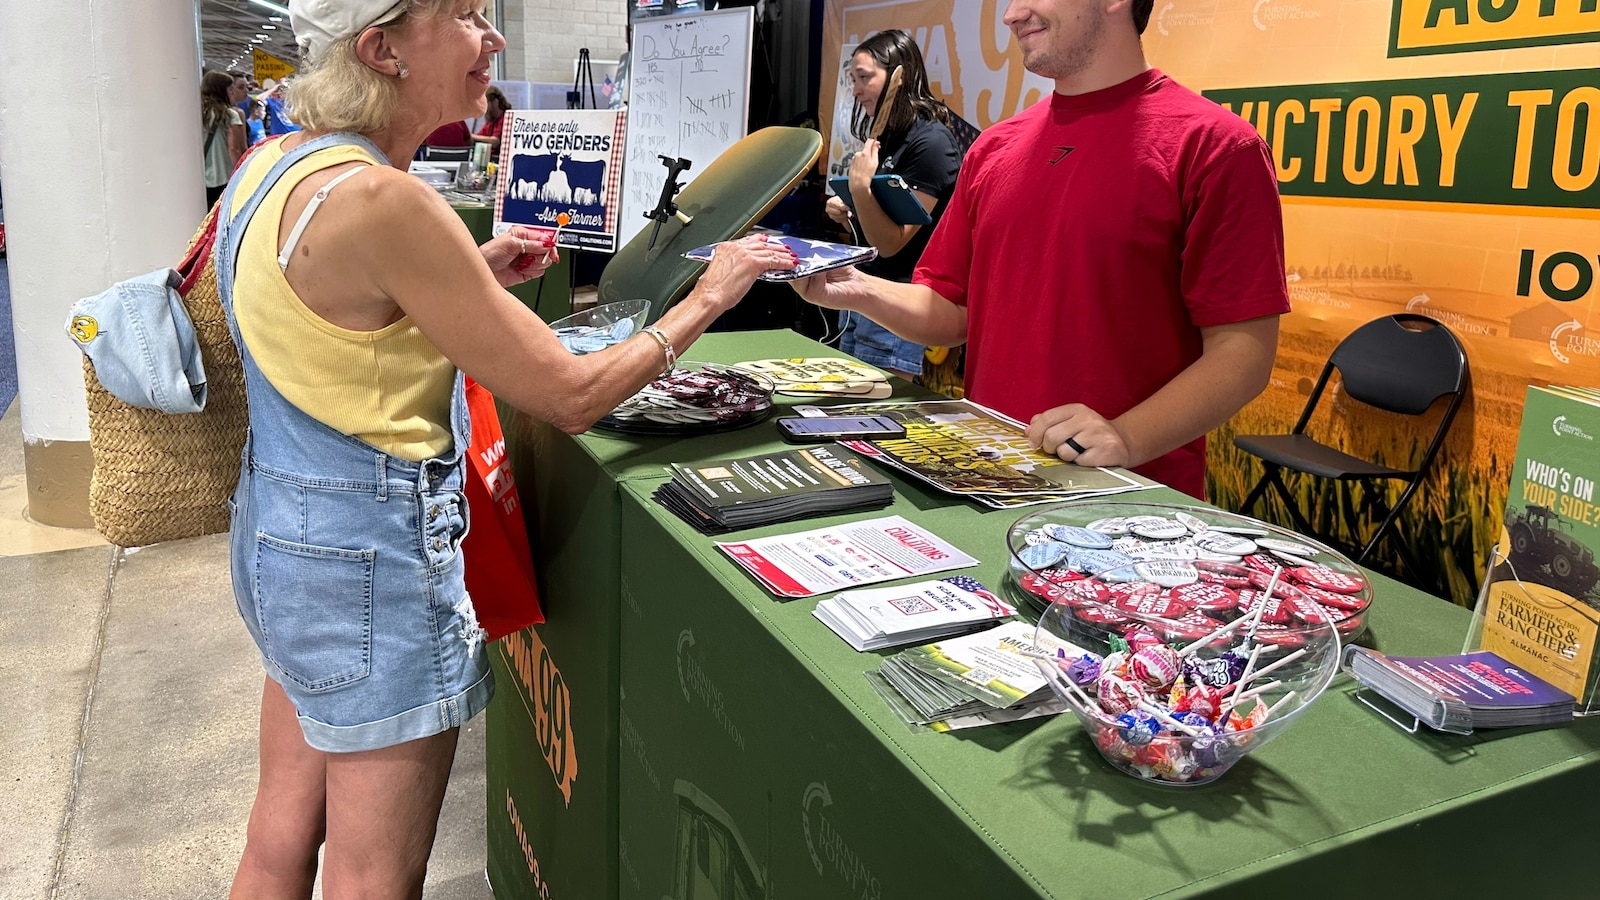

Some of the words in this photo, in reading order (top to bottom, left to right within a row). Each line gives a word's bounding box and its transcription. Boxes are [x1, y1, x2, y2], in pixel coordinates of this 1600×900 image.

[642, 35, 660, 59] Do
[669, 35, 685, 58] You
[690, 34, 731, 61] Agree?
[256, 63, 285, 71] PASSING
[514, 117, 540, 133] There
[540, 122, 556, 133] are
[557, 119, 579, 134] only
[513, 134, 543, 150] TWO
[546, 134, 611, 152] GENDERS
[567, 208, 604, 227] Farmer
[1517, 248, 1600, 302] IO
[1420, 307, 1465, 322] TURNING
[1526, 458, 1571, 494] WHO'S
[1573, 476, 1594, 502] ON
[1522, 479, 1558, 512] YOUR
[1558, 494, 1600, 528] SIDE?
[881, 526, 951, 560] COALITIONS
[923, 590, 957, 612] REGISTER
[936, 585, 958, 600] SCAN
[954, 597, 977, 611] HERE
[943, 596, 955, 604] TO
[1136, 593, 1158, 613] CHASE
[1152, 597, 1172, 613] VOTE
[1178, 585, 1224, 602] CHASE
[1193, 590, 1230, 604] VOTE
[1501, 591, 1532, 611] TURNING
[1264, 598, 1282, 616] VOTE
[1532, 605, 1554, 622] POINT
[1554, 615, 1581, 633] ACTION
[1499, 597, 1564, 638] FARMERS
[1564, 629, 1578, 645] &
[1510, 638, 1549, 663] ALMANAC
[502, 630, 534, 702] OWA
[687, 651, 724, 710] TURNING
[539, 647, 566, 787] 99
[687, 668, 711, 709] POINT
[712, 702, 745, 753] ACTION
[818, 811, 881, 899] TURNING
[819, 831, 860, 892] POINT
